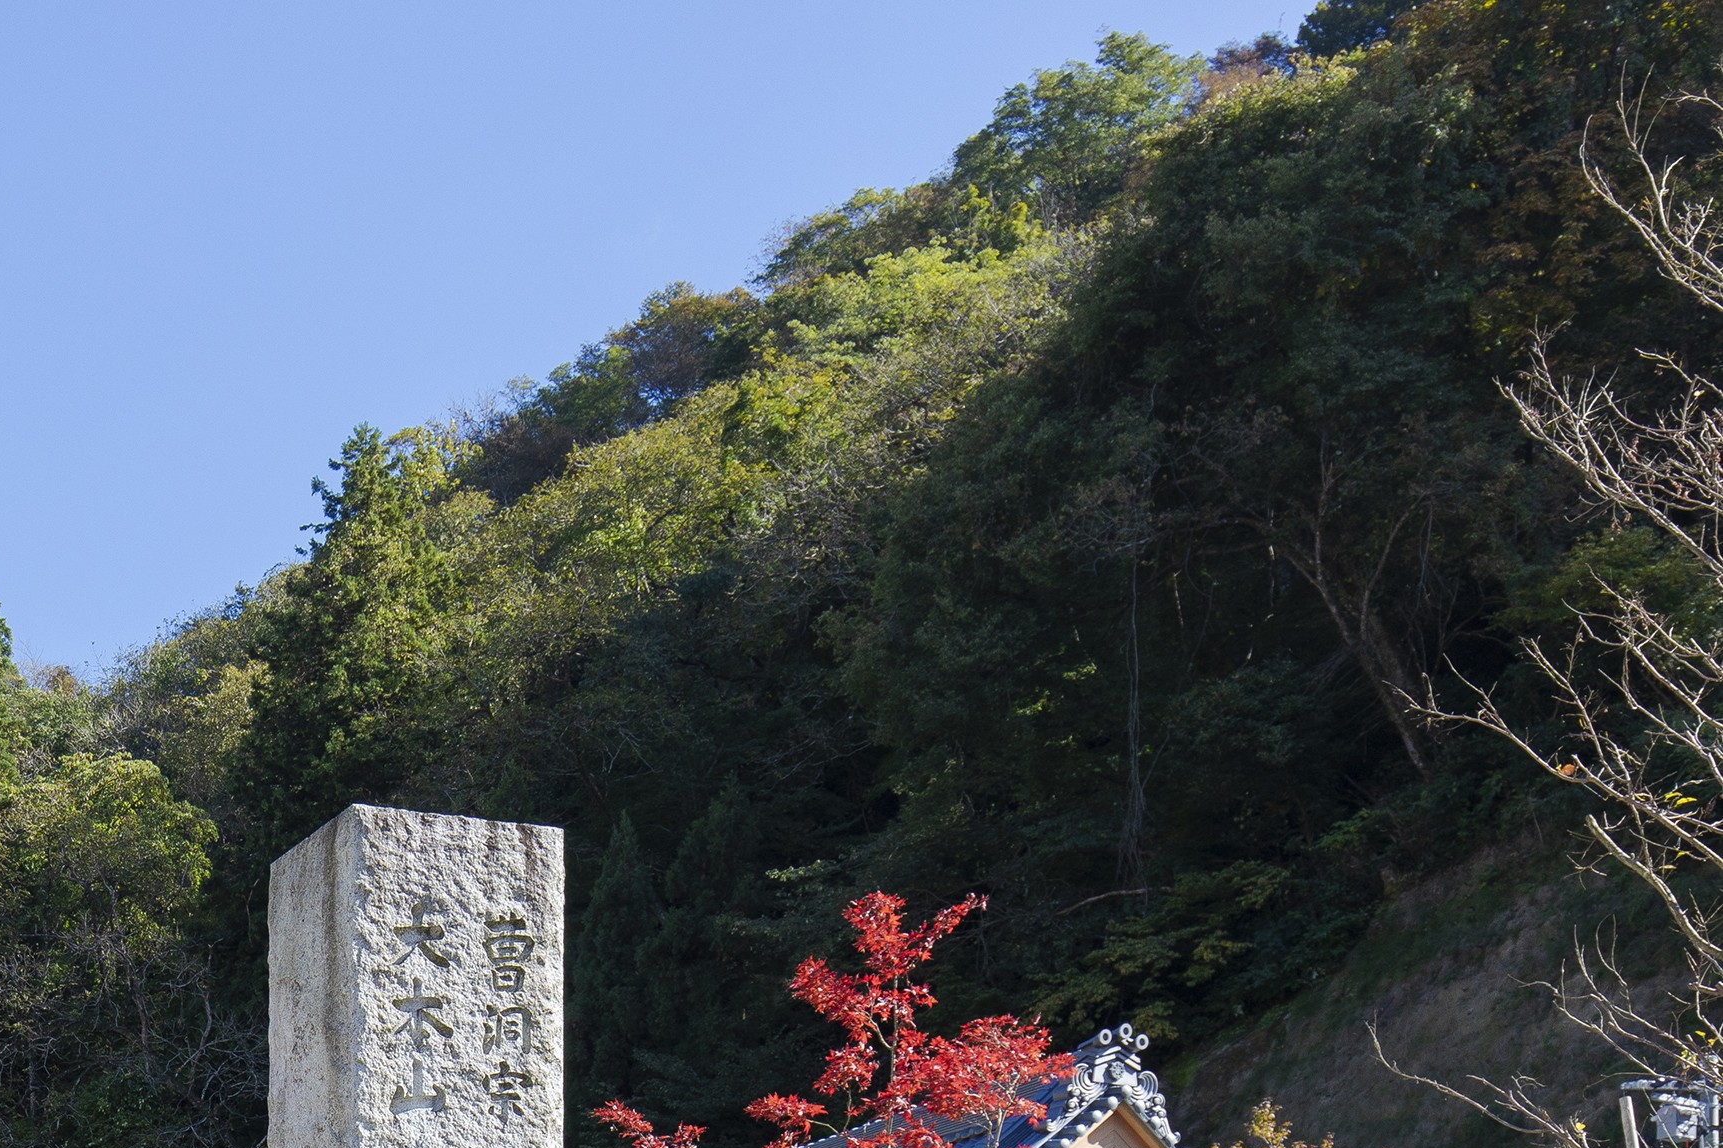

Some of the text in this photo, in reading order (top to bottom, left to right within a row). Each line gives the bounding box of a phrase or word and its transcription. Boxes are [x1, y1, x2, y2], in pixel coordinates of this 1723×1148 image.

[389, 901, 455, 1115] 大本山
[482, 912, 535, 1126] 曹洞宗
